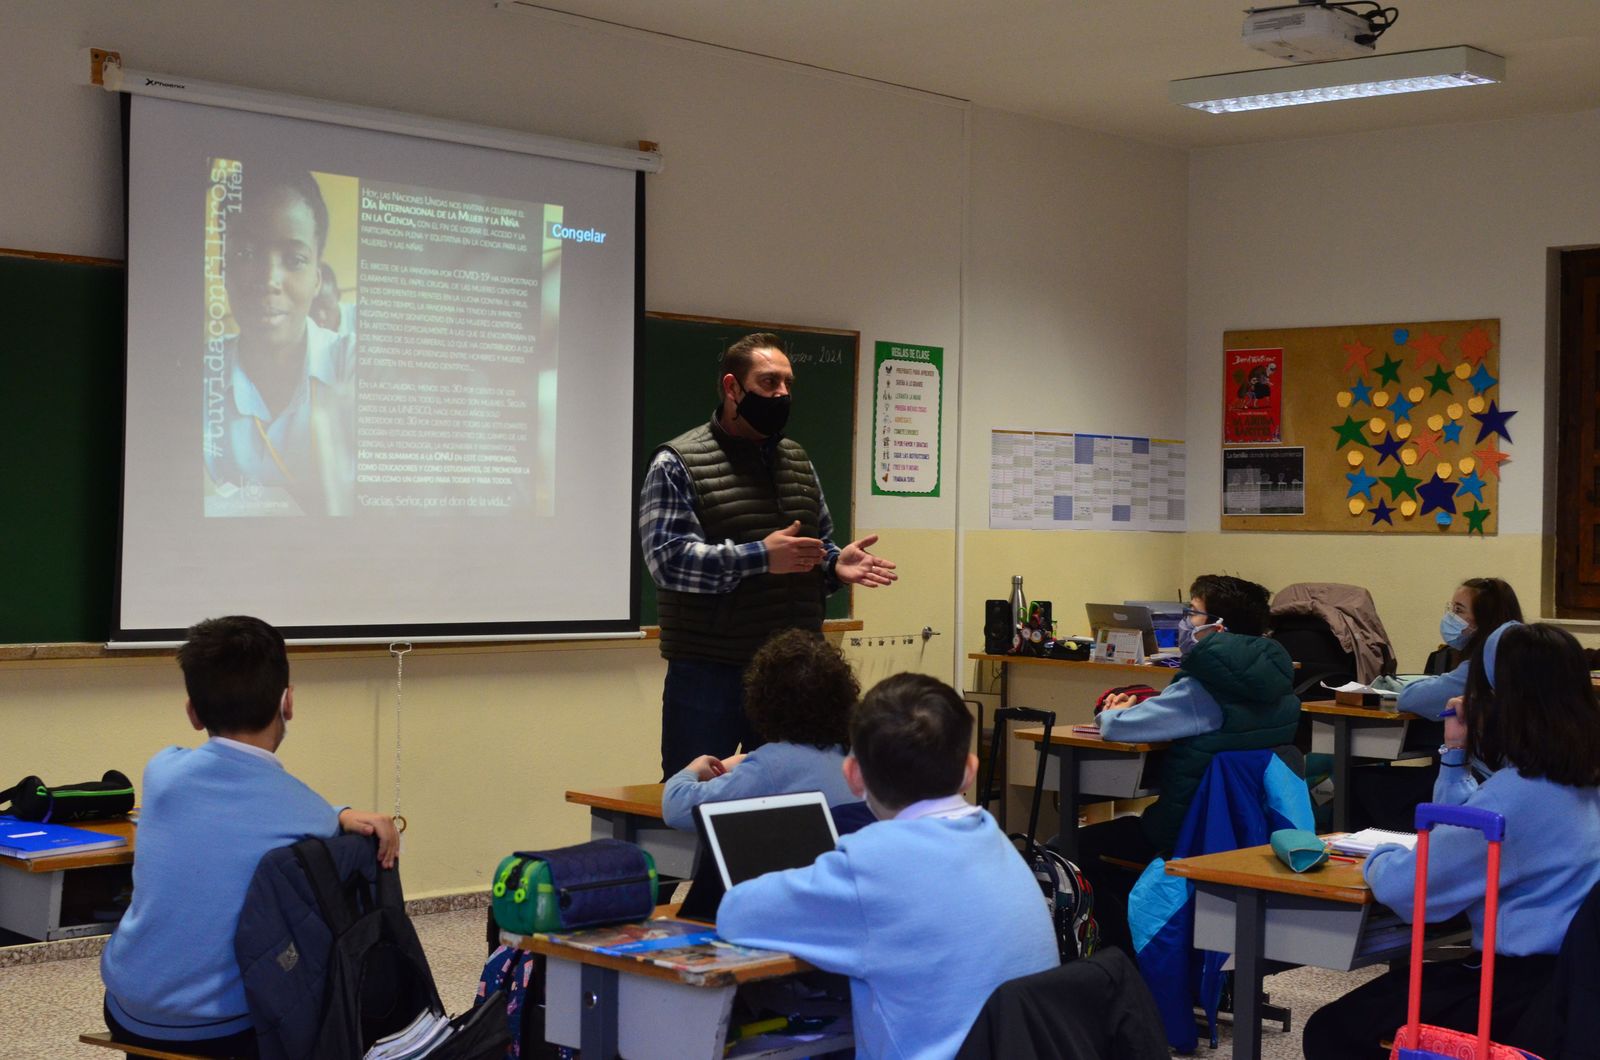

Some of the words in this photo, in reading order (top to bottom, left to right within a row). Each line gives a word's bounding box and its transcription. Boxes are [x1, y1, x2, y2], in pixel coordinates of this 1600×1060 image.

[227, 161, 242, 213] 11feb
[361, 213, 372, 221] EN
[373, 214, 382, 223] LA
[447, 211, 456, 220] LA
[490, 216, 499, 225] LA
[552, 223, 606, 244] Congelar
[891, 347, 909, 358] REGLAS
[909, 349, 915, 359] DE
[915, 350, 931, 360] CLASE
